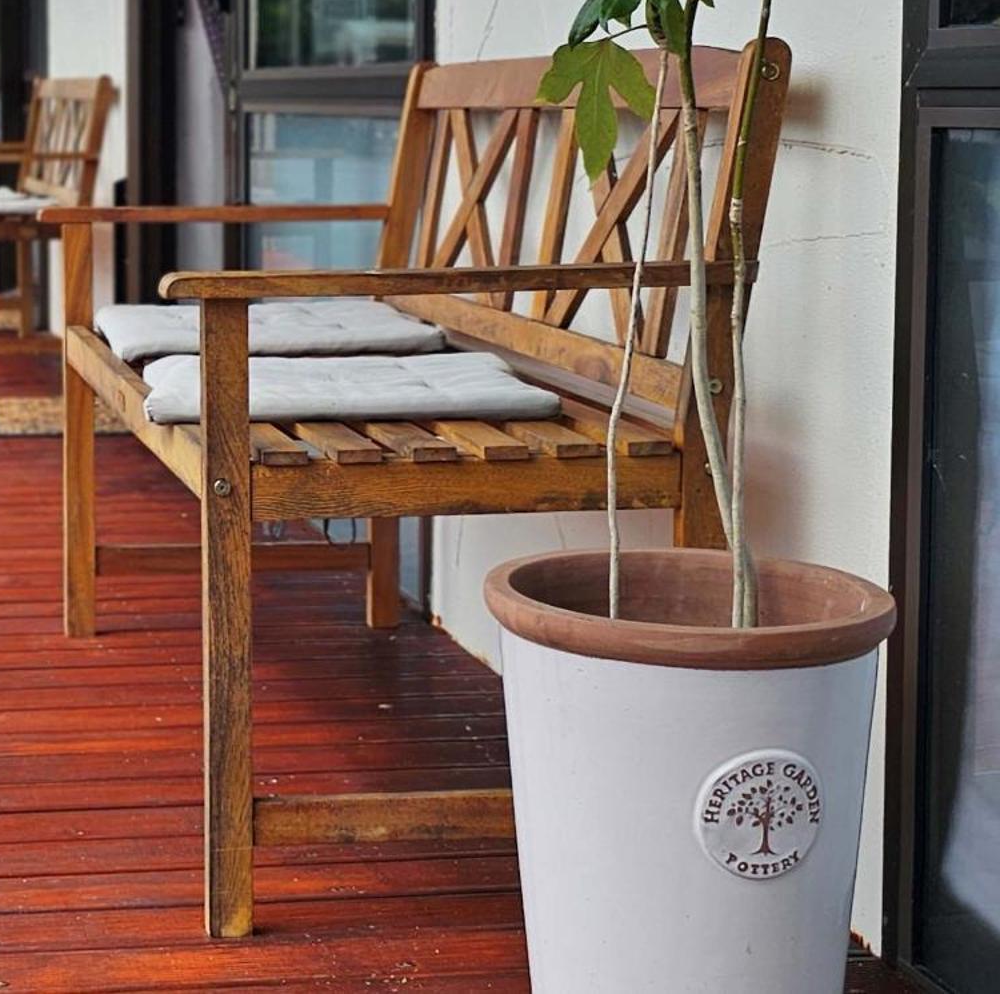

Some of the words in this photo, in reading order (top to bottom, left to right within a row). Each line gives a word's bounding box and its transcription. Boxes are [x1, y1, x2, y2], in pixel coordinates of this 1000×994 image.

[704, 762, 776, 824] HERITAGE
[783, 763, 820, 824] GARDEN
[725, 849, 801, 875] POTTERY
